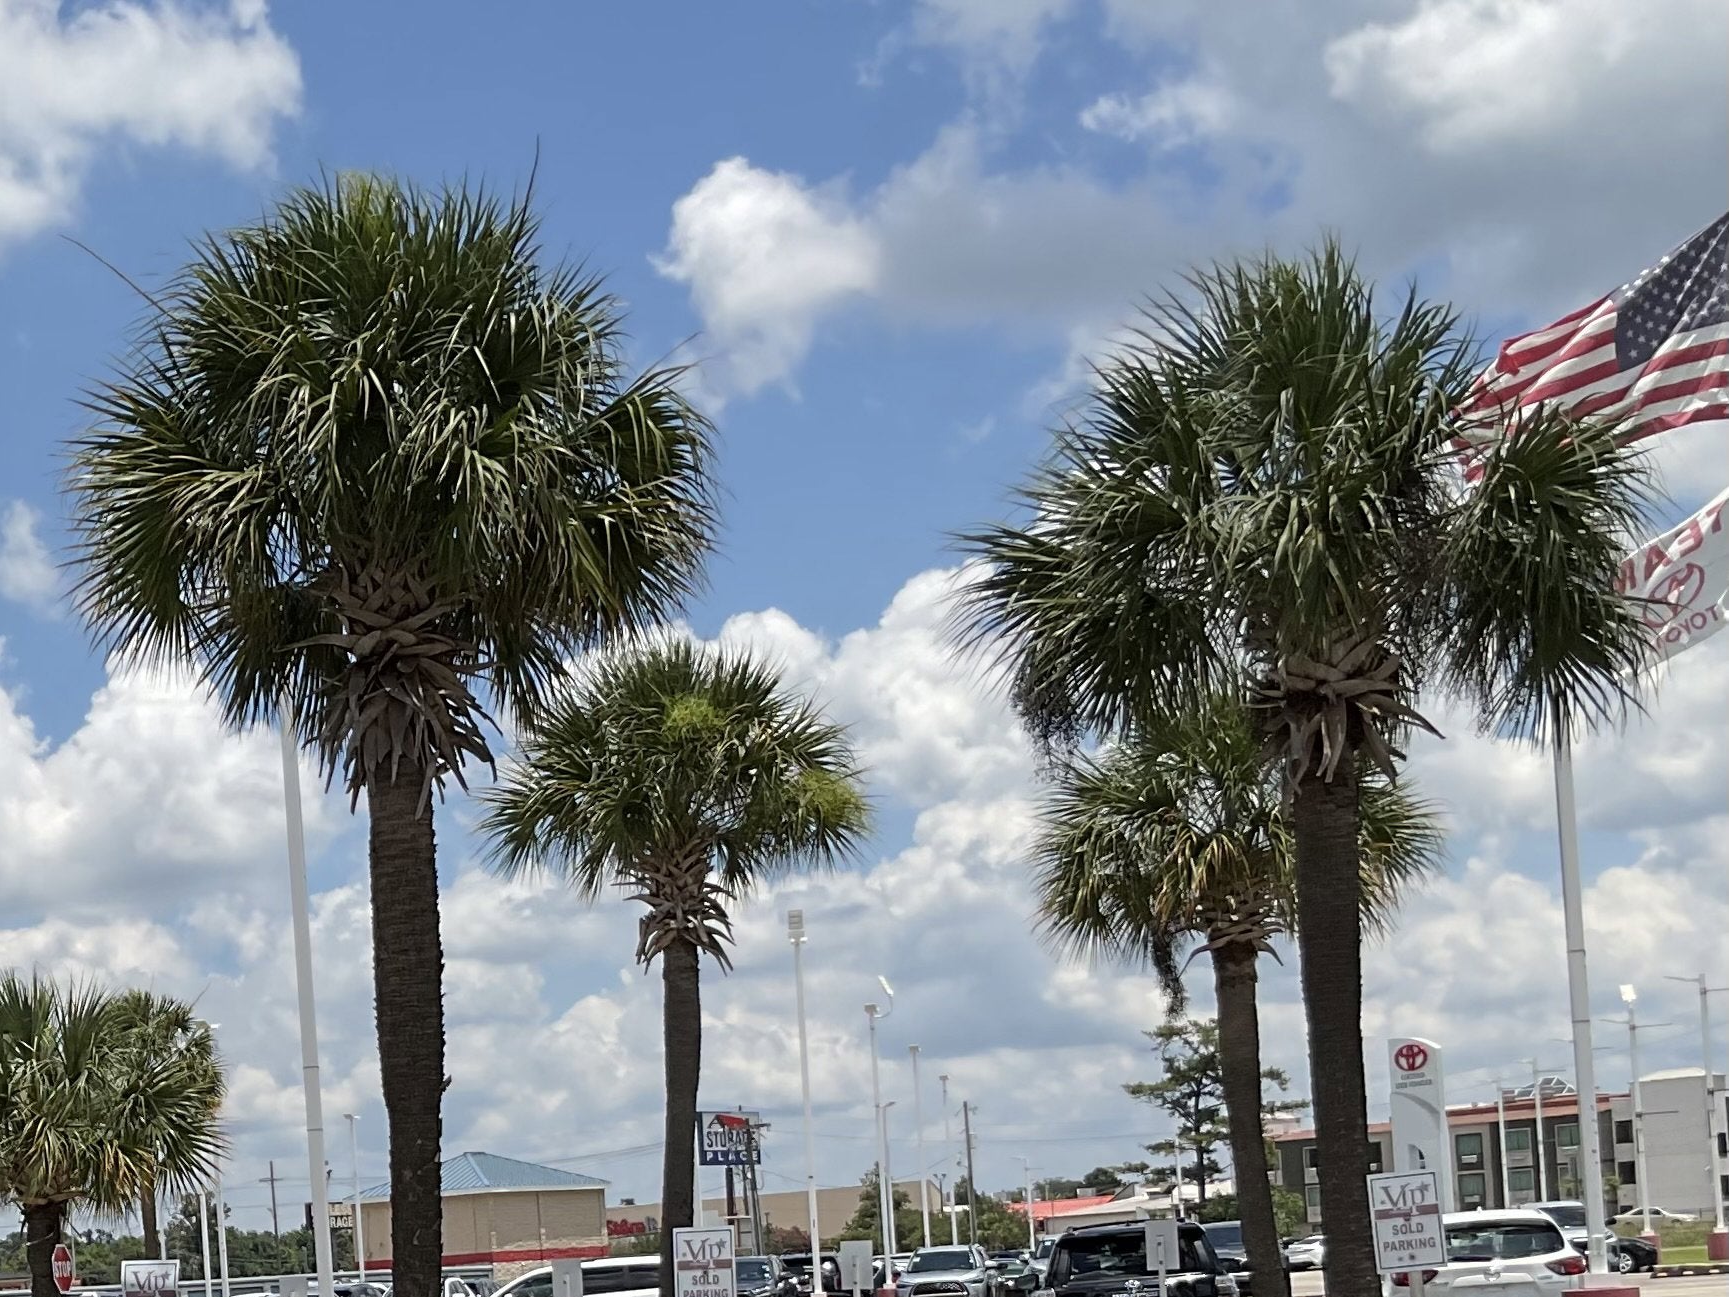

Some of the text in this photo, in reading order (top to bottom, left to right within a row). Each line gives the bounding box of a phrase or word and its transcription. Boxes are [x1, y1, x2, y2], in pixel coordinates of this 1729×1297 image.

[706, 1151, 758, 1161] PLACE
[1392, 1223, 1424, 1235] SOLD
[1383, 1237, 1436, 1252] PARKING
[692, 1274, 720, 1286] SOLD
